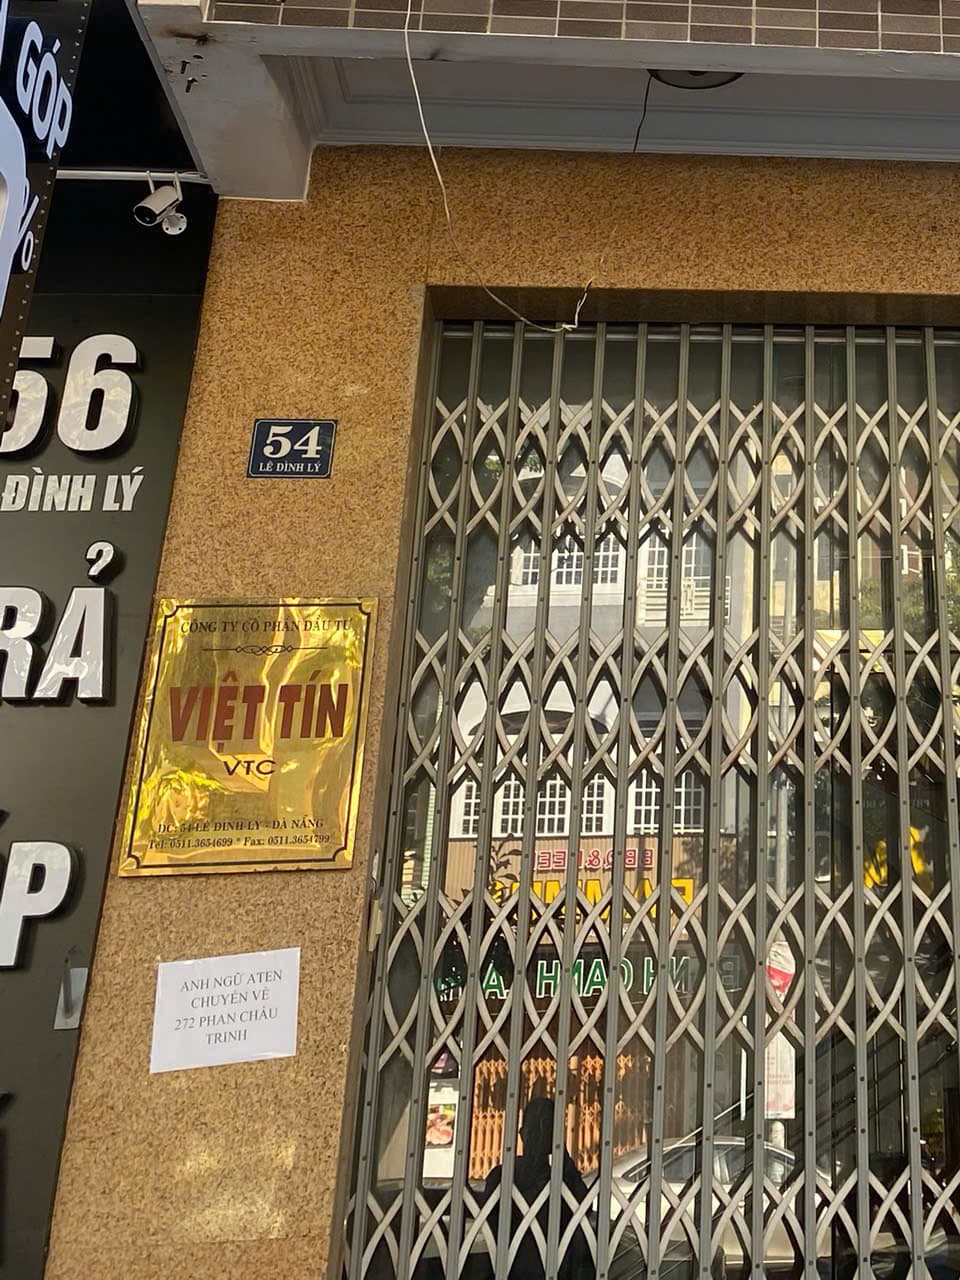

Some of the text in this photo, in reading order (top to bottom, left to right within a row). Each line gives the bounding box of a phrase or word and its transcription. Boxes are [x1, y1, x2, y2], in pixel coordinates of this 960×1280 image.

[16, 20, 73, 160] GÓP
[263, 425, 322, 458] 54
[259, 460, 273, 472] LÊ
[307, 459, 322, 472] LÝ
[0, 466, 144, 512] ĐÌNH LÝ
[180, 620, 217, 633] CÔNG
[221, 620, 239, 633] TY
[334, 617, 354, 632] TƯ
[169, 666, 349, 753] VIỆT TÍN
[223, 759, 277, 777] VTC
[243, 836, 265, 847] Fax:
[180, 970, 283, 992] ANH NGỮ ATEN
[252, 986, 271, 1001] VỀ
[174, 1006, 278, 1031] 272 PHAN CHÂU
[205, 1029, 248, 1045] TRINH
